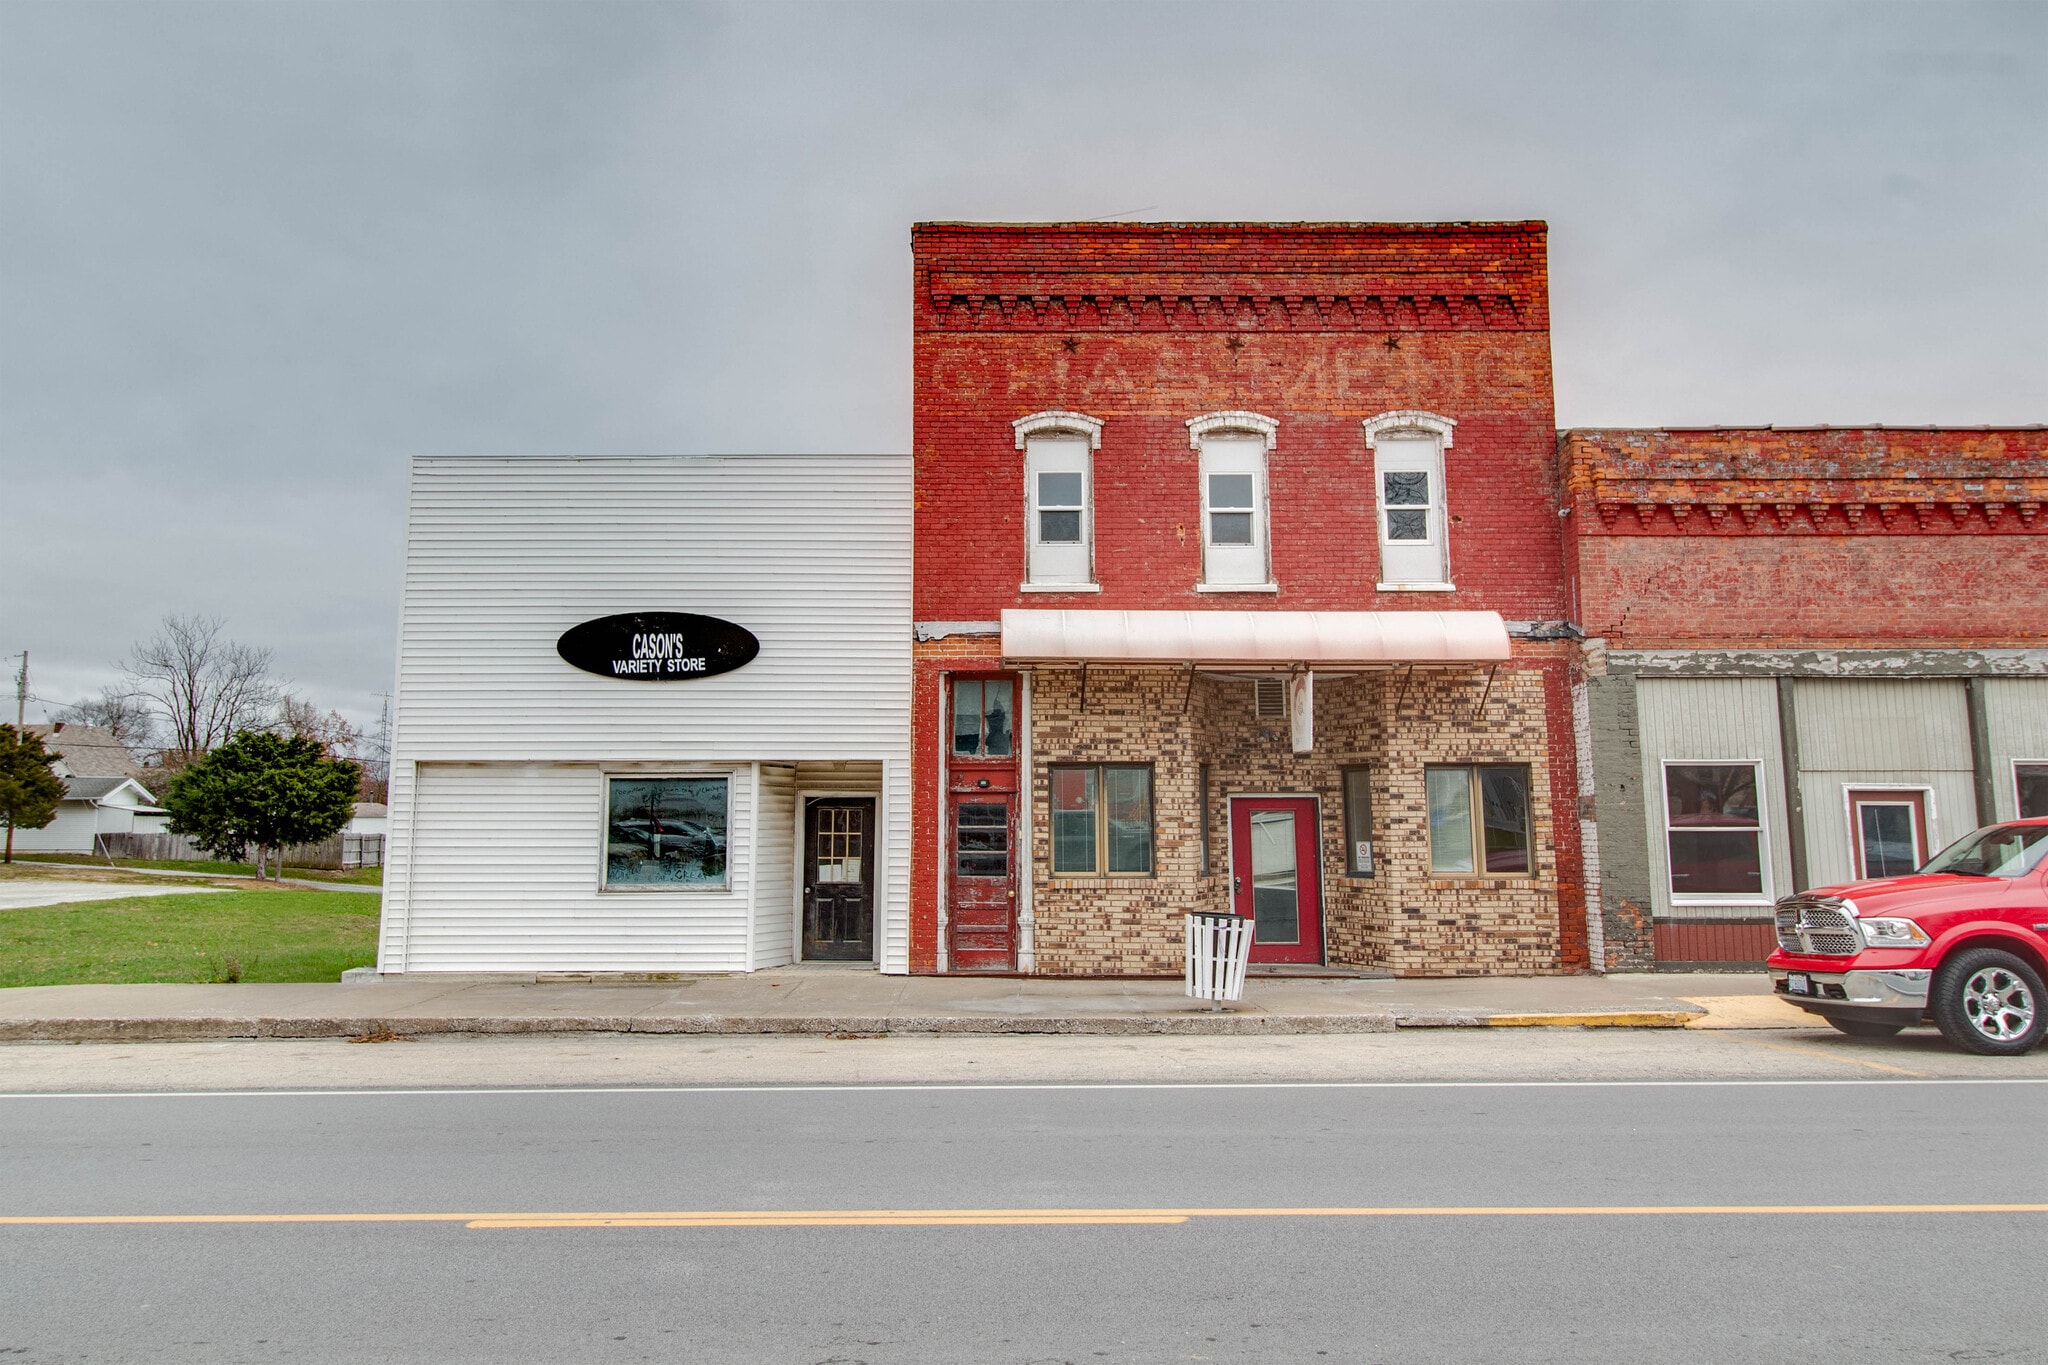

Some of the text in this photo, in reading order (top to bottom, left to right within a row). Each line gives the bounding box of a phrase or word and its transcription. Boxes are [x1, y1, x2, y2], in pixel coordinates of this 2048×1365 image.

[632, 633, 683, 659] CASON'S
[612, 658, 706, 674] VARIETY STORE
